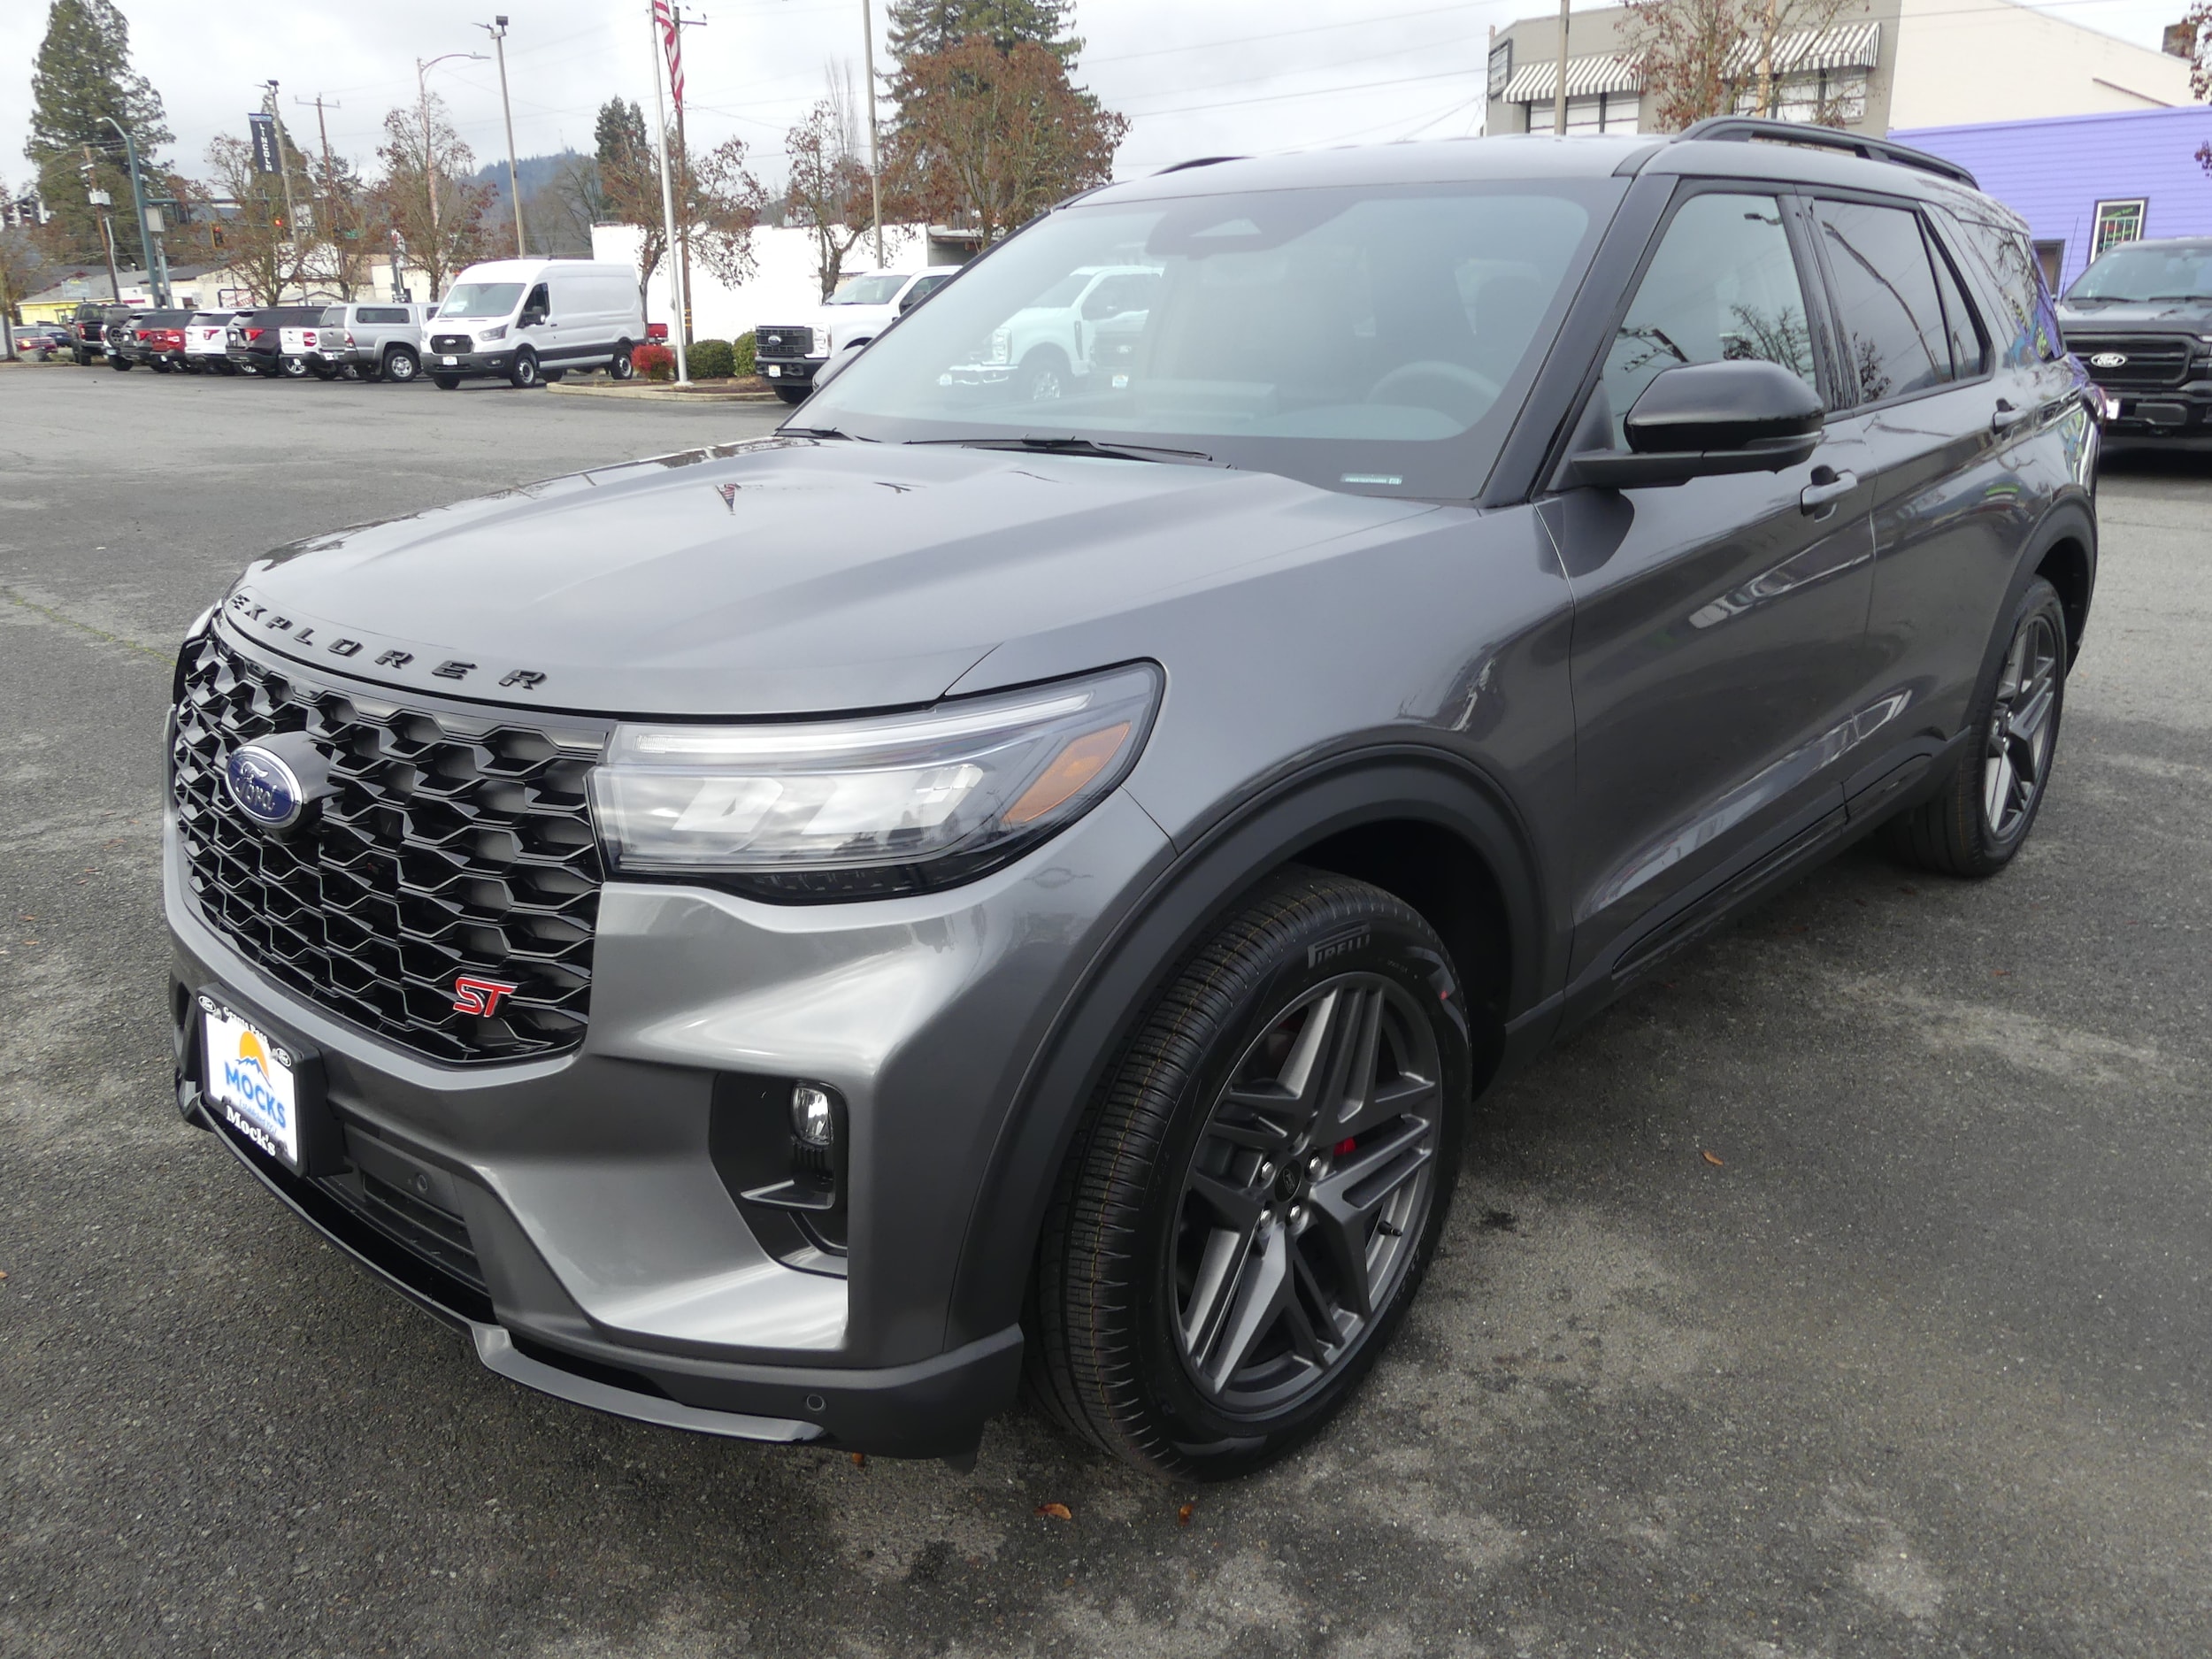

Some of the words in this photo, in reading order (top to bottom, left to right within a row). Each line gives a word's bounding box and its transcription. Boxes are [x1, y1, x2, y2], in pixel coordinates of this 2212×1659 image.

[258, 122, 273, 172] LINCOLN
[230, 594, 548, 690] EXPLORER
[235, 761, 278, 812] Ford
[1308, 923, 1371, 969] PIRELLI
[453, 975, 518, 1018] ST
[225, 1060, 287, 1128] MOCKS
[227, 1105, 276, 1156] Mock's
